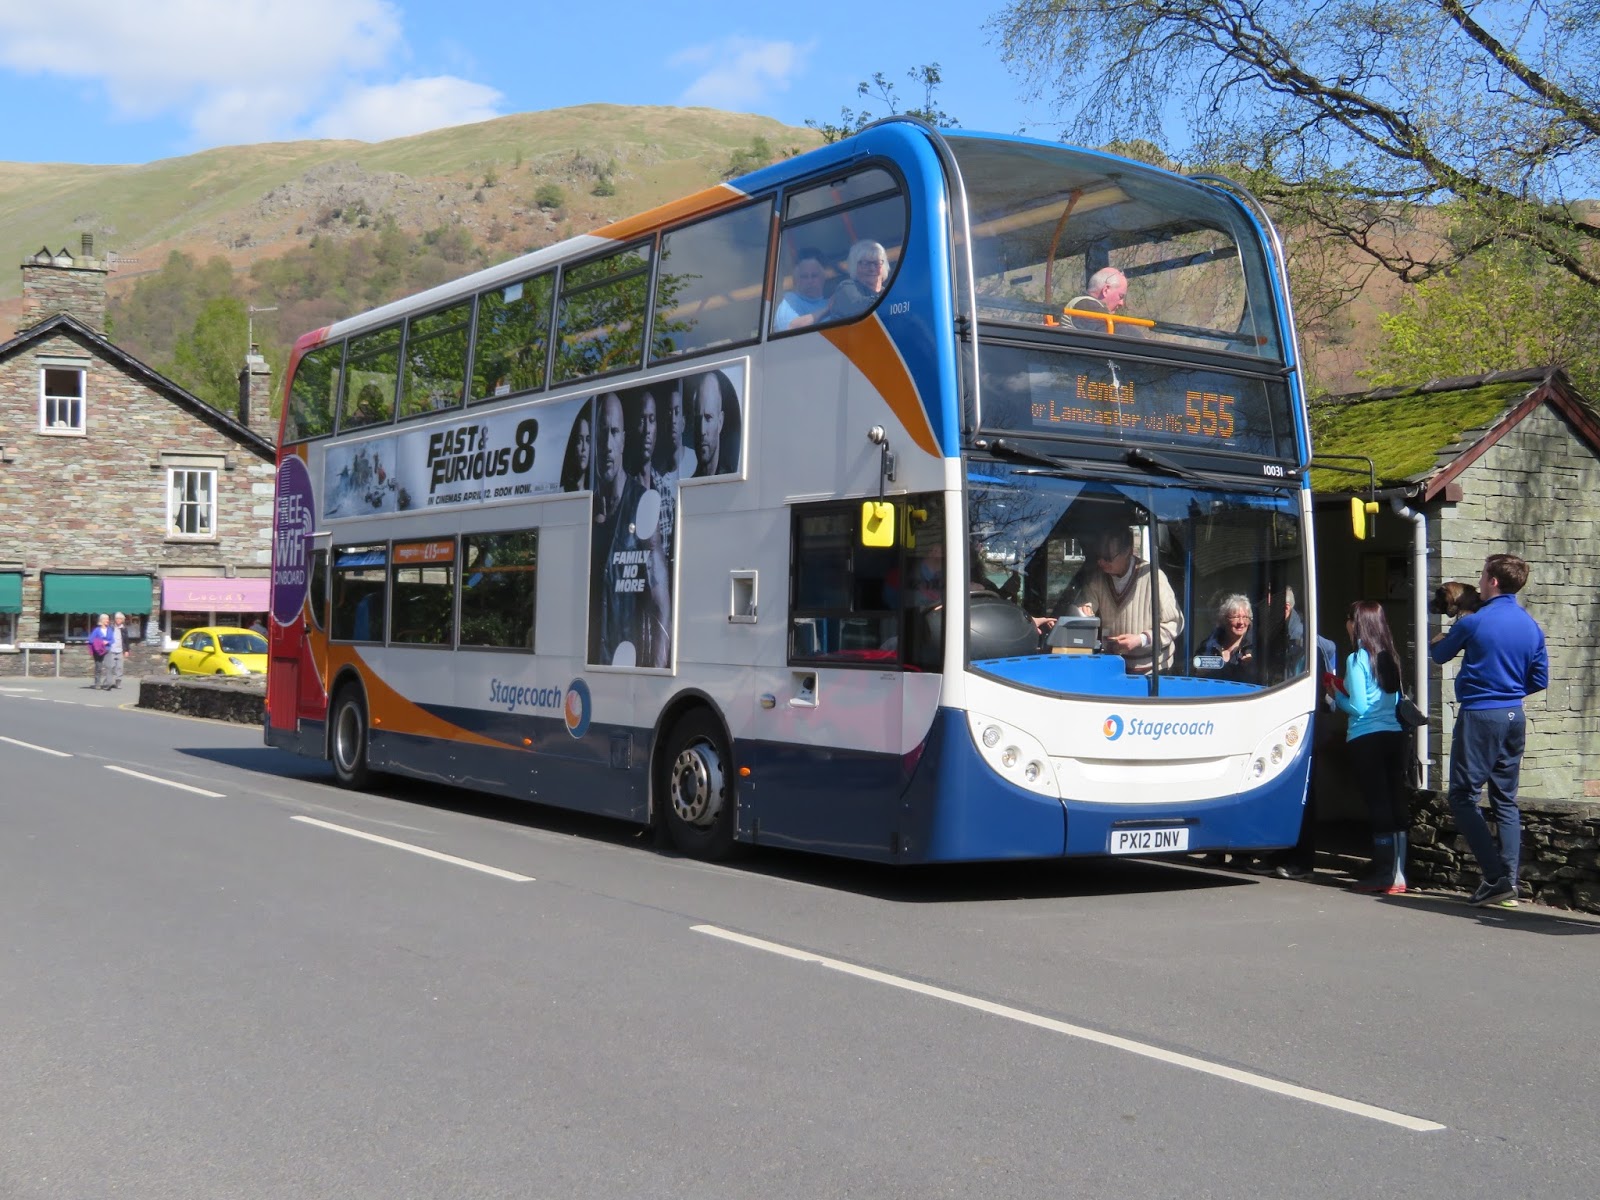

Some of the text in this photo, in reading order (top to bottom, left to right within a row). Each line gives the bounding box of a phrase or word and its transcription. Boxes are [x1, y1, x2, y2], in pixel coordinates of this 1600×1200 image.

[890, 301, 910, 315] 10031
[1076, 374, 1135, 404] Kendal
[1031, 403, 1047, 418] or
[1049, 400, 1141, 427] Lancaster
[1185, 391, 1235, 438] 555
[427, 425, 479, 468] FAST
[430, 418, 538, 494] FURIOUS 8
[1263, 464, 1284, 477] 10031
[435, 493, 462, 505] CINEMAS
[463, 491, 482, 501] APRIL
[493, 486, 512, 497] BOOK
[612, 550, 651, 564] FAMILY
[275, 570, 305, 585] ONBOARD
[622, 564, 638, 578] NO
[615, 579, 645, 592] MORE
[489, 678, 562, 711] Stagecoach
[1128, 718, 1214, 740] Stagecoach
[1119, 831, 1180, 849] PX12 DNV
